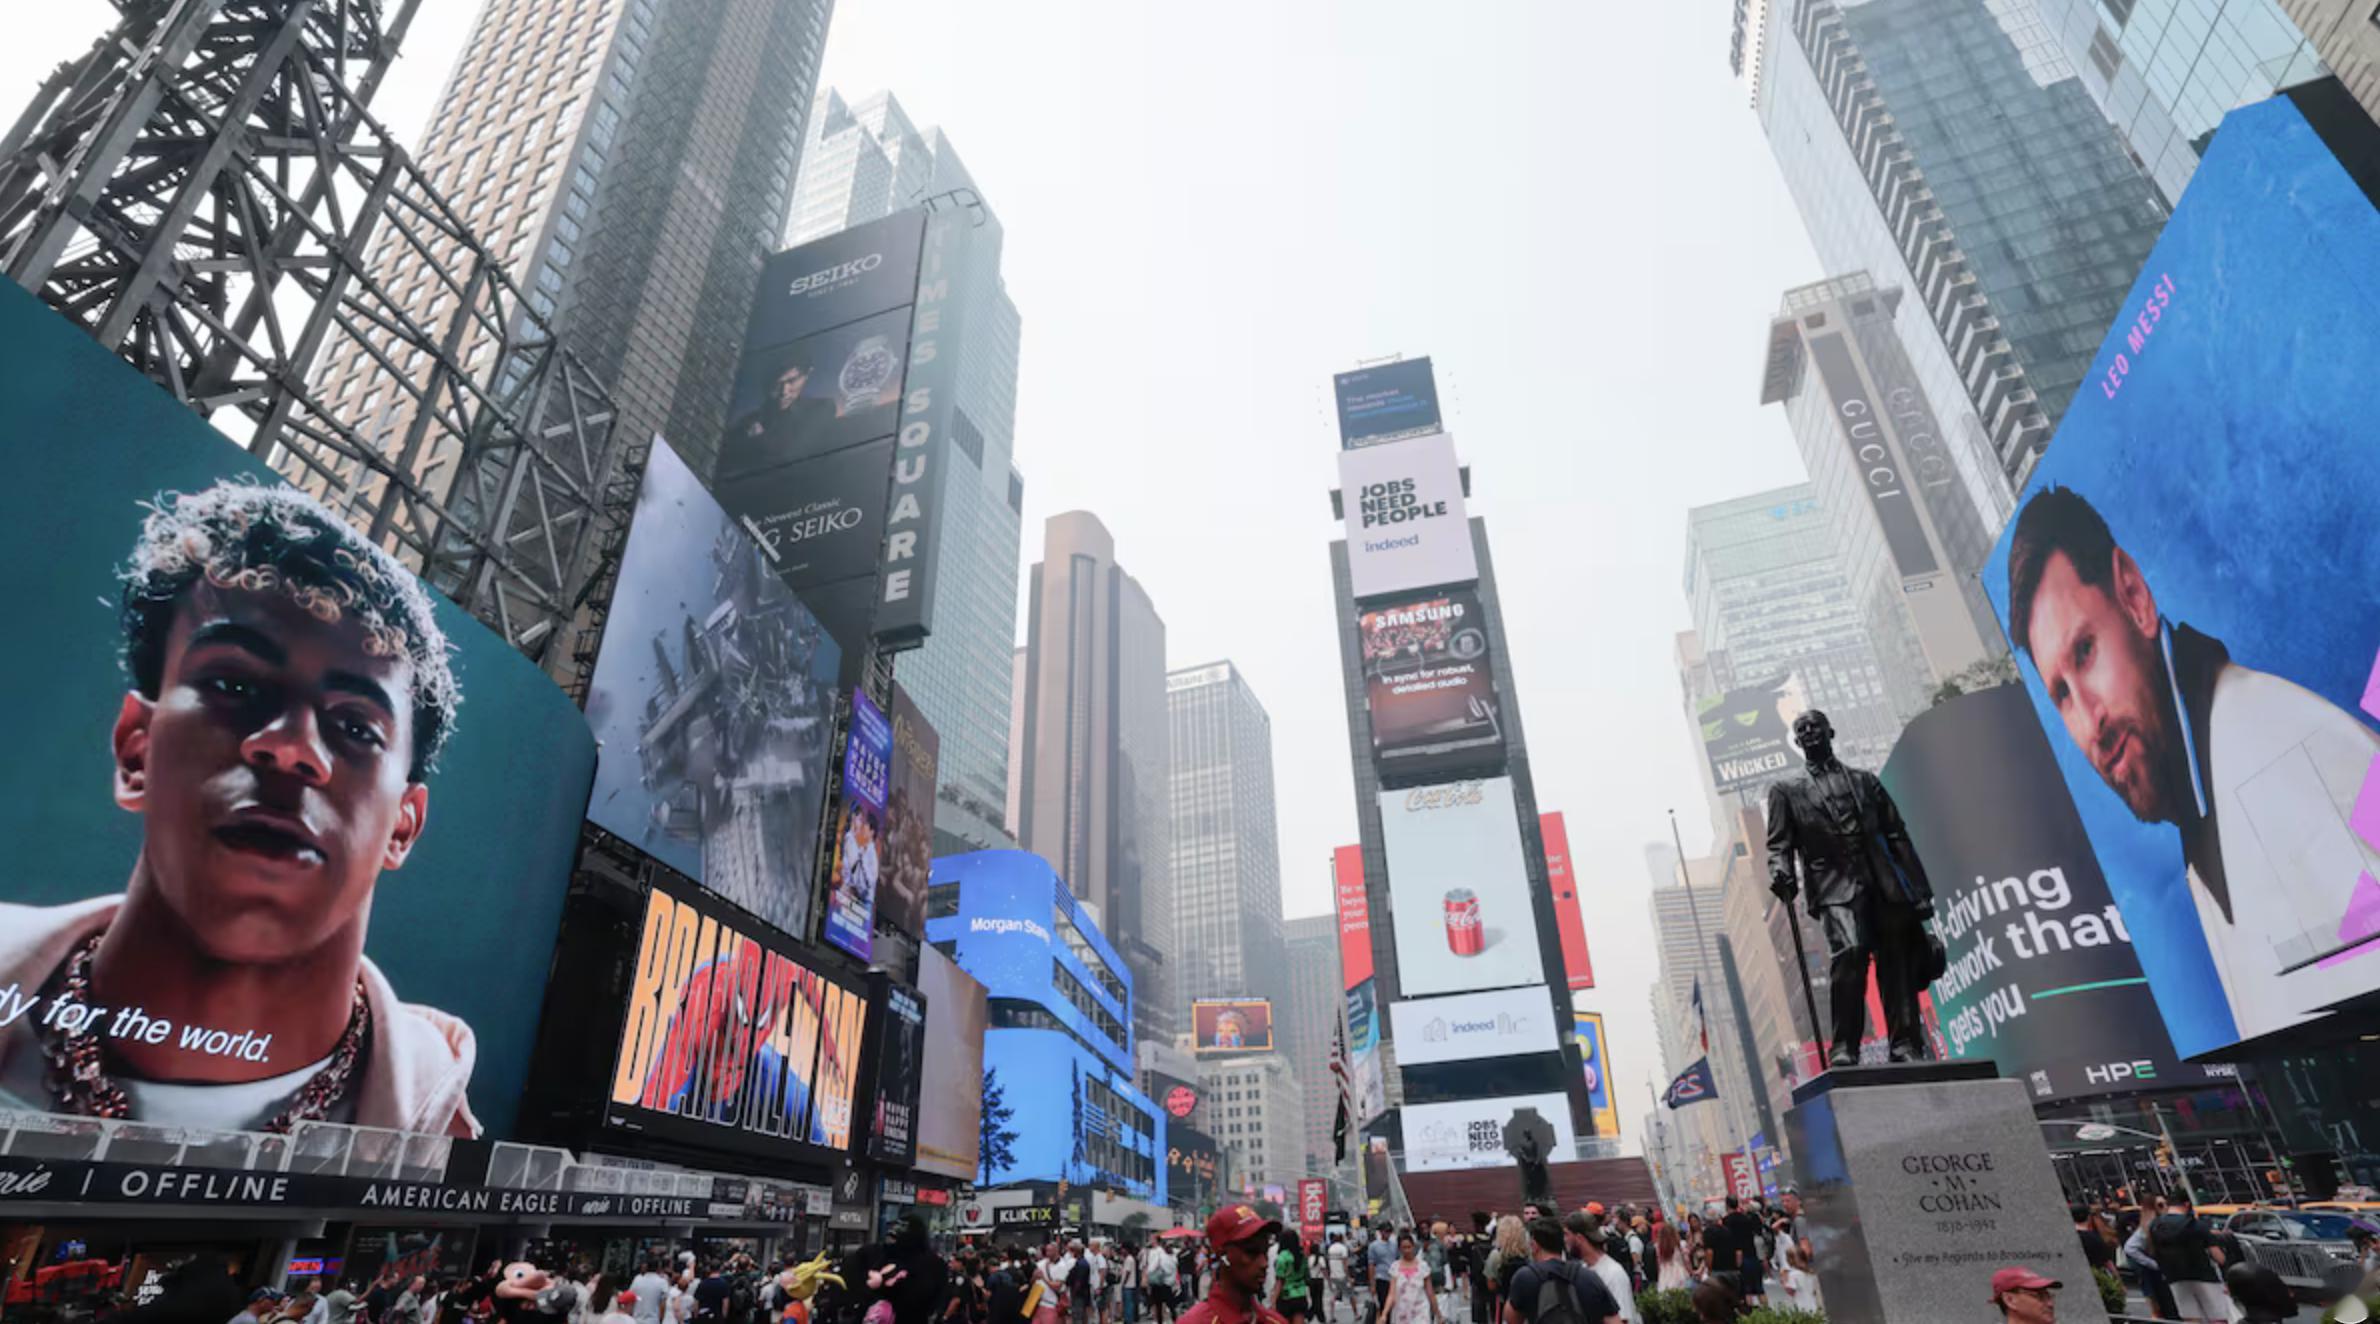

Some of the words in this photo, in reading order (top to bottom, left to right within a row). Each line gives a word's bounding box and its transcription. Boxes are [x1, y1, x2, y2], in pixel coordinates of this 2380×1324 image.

[789, 253, 883, 296] SEIKO
[2101, 353, 2129, 400] LEO
[2127, 272, 2177, 355] MESSI
[1841, 398, 1901, 499] GUCCI
[885, 389, 931, 602] SQUARE
[1360, 478, 1416, 500] JOBS
[1361, 493, 1417, 514] NEED
[1362, 501, 1448, 529] PEOPLE
[789, 507, 863, 543] SEIKO
[1365, 534, 1419, 553] indeed
[1375, 603, 1465, 629] SAMSUNG
[969, 917, 1024, 935] Morgan
[1934, 930, 2004, 1005] network
[2005, 904, 2132, 959] that
[42, 991, 107, 1030] for
[109, 1007, 171, 1043] the
[179, 1024, 272, 1063] world.
[612, 886, 763, 1127] BRAND
[741, 948, 826, 1142] NEW
[1451, 1020, 1495, 1034] indeed
[1948, 1005, 1985, 1056] gets
[1979, 983, 2027, 1039] you
[2085, 1059, 2157, 1085] HPE
[1468, 1119, 1498, 1132] JOBS
[1468, 1130, 1500, 1142] NEED
[1469, 1139, 1503, 1152] PEOP
[1901, 1152, 1995, 1175] GEORGE
[121, 1170, 289, 1200] OFFLINE
[1944, 1175, 1968, 1192] M
[361, 1183, 490, 1211] AMERICAN
[500, 1193, 559, 1213] EAGLE
[631, 1197, 692, 1215] OFFLINE
[1305, 1181, 1322, 1222] tkts
[1918, 1192, 2003, 1213] COHAN
[999, 1206, 1052, 1223] KLIKTIX
